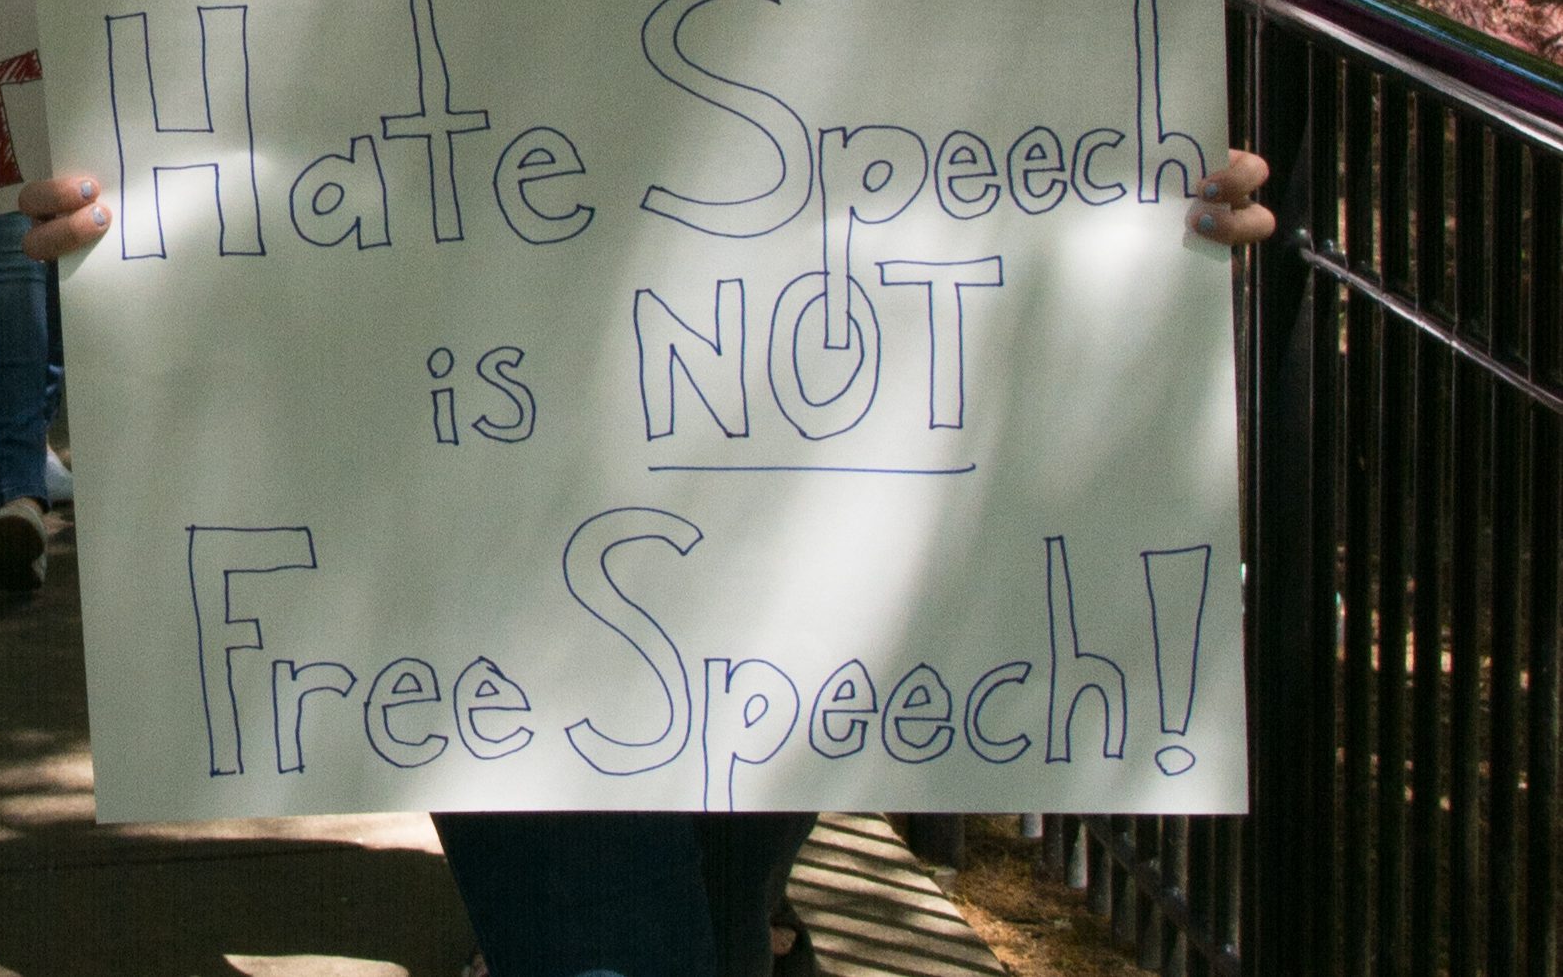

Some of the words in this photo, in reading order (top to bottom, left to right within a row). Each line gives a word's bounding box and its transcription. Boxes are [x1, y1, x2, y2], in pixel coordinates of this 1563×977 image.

[425, 346, 537, 444] is
[634, 255, 1003, 441] NOT
[184, 524, 534, 776] Free
[561, 506, 1211, 813] Speech!
